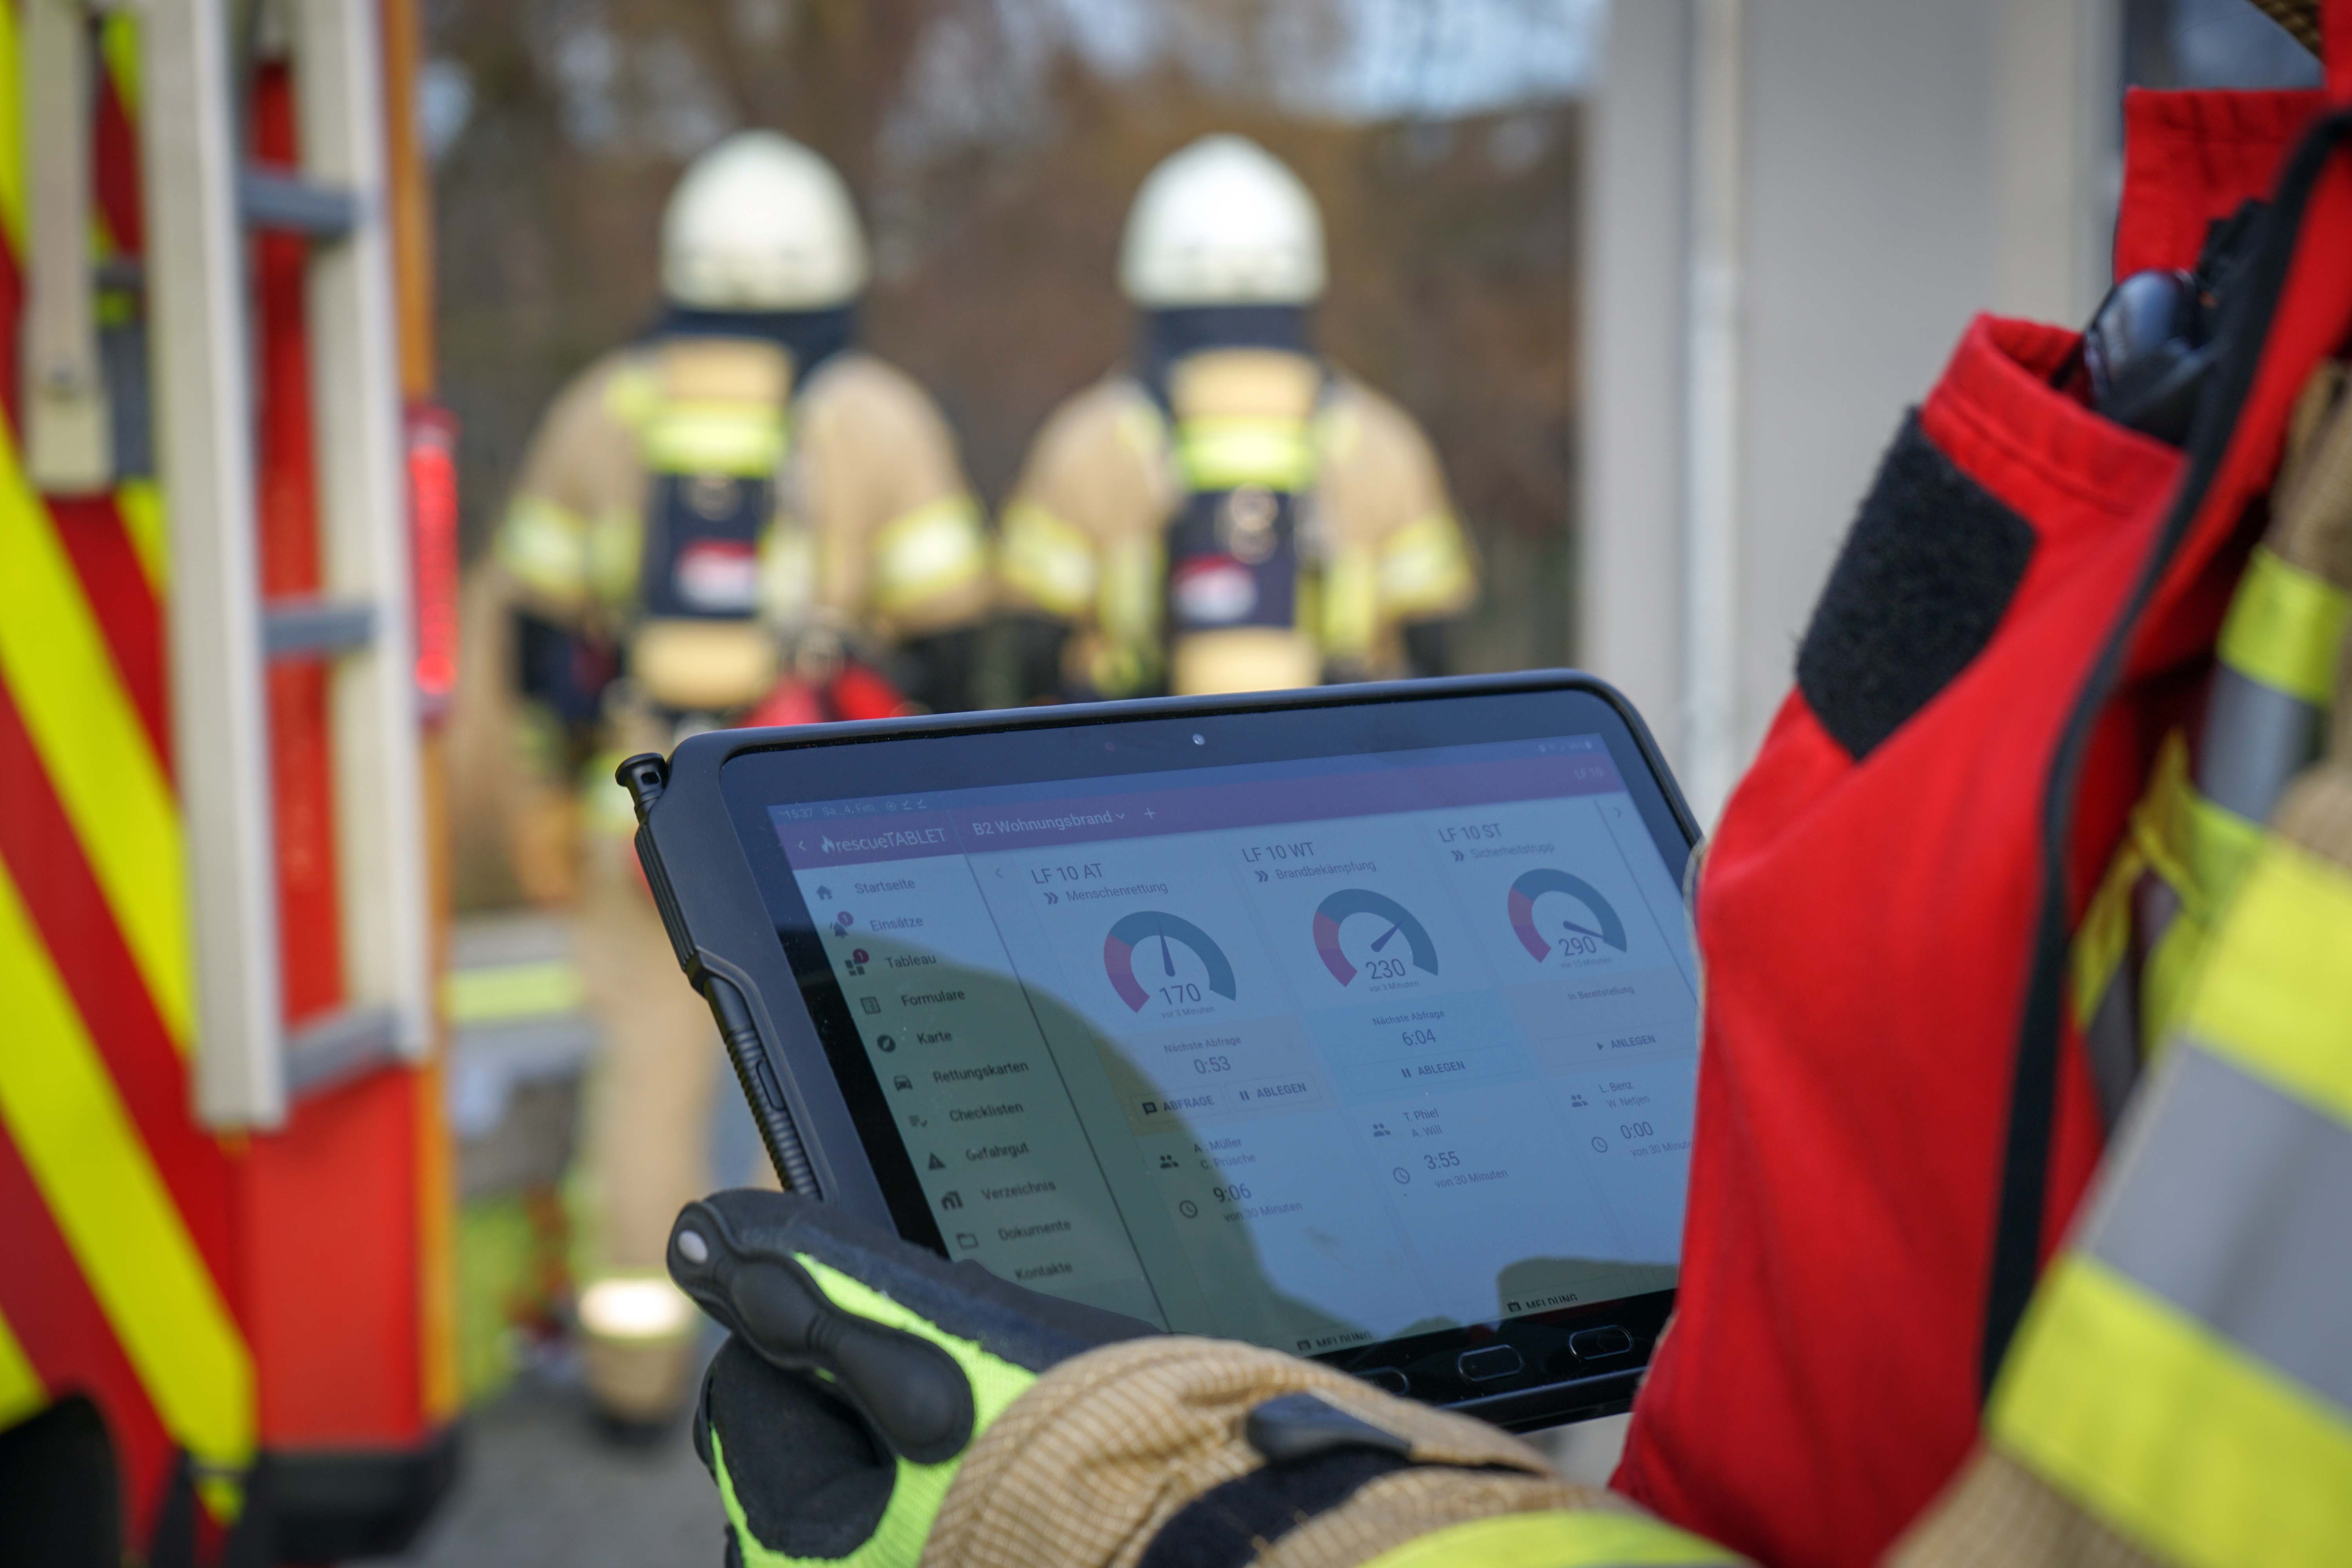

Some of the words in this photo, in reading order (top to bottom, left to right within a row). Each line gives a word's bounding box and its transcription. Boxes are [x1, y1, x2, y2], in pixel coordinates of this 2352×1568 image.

[973, 823, 994, 835] B2
[995, 811, 1112, 833] Wohnungsbrand
[835, 828, 946, 852] rescueTABLET
[1438, 828, 1457, 843] LF
[1461, 826, 1481, 840] 10
[1483, 824, 1503, 838] ST
[1241, 847, 1261, 862] LF
[1266, 845, 1287, 860] 10
[1289, 842, 1315, 857] WT
[1031, 868, 1052, 884] LF
[1056, 865, 1079, 882] 10
[1083, 864, 1104, 880] AT
[1276, 860, 1377, 880] Brandbekämpfung
[855, 878, 915, 894] Startseite
[1066, 882, 1169, 902] Menschenrettung
[870, 916, 923, 932] Einsätze
[1559, 936, 1596, 956] 290
[885, 954, 936, 969] Tableau
[1366, 959, 1406, 980] 230
[1388, 980, 1420, 989] Minuten
[901, 990, 965, 1007] Formulare
[1159, 983, 1201, 1006] 170
[1182, 1006, 1216, 1016] Minuten
[1372, 1013, 1409, 1026] Nächste
[1411, 1009, 1445, 1022] Abfrage
[916, 1031, 952, 1045] Karte
[1164, 1040, 1203, 1053] Nächste
[1205, 1035, 1241, 1050] Abfrage
[1402, 1028, 1436, 1046] 6:04
[1611, 1034, 1656, 1048] ANLEGEN
[933, 1061, 1029, 1083] Rettungskarten
[1194, 1056, 1231, 1074] 0:53
[1418, 1060, 1466, 1076] ABLEGEN
[1257, 1082, 1307, 1098] ABLEGEN
[1609, 1082, 1633, 1092] Benz
[949, 1102, 1024, 1122] Checklisten
[1163, 1095, 1214, 1112] ABFRAGE
[1403, 1112, 1413, 1121] T.
[1414, 1108, 1439, 1120] Phiel
[1422, 1125, 1443, 1136] Will
[1620, 1122, 1653, 1139] 0:00
[965, 1142, 1029, 1162] Gefahrgut
[1209, 1138, 1241, 1151] Müller
[1631, 1148, 1648, 1156] von
[1649, 1144, 1661, 1154] 30
[1424, 1151, 1461, 1170] 3:55
[1434, 1178, 1454, 1189] von
[1454, 1175, 1467, 1185] 30
[1468, 1169, 1508, 1183] Minuten
[981, 1180, 1056, 1200] Verzeichnis
[1213, 1183, 1251, 1203] 9:06
[1223, 1211, 1244, 1222] von
[1259, 1203, 1303, 1215] Minuten
[998, 1220, 1071, 1241] Dokumente
[1015, 1263, 1073, 1280] Kontakte
